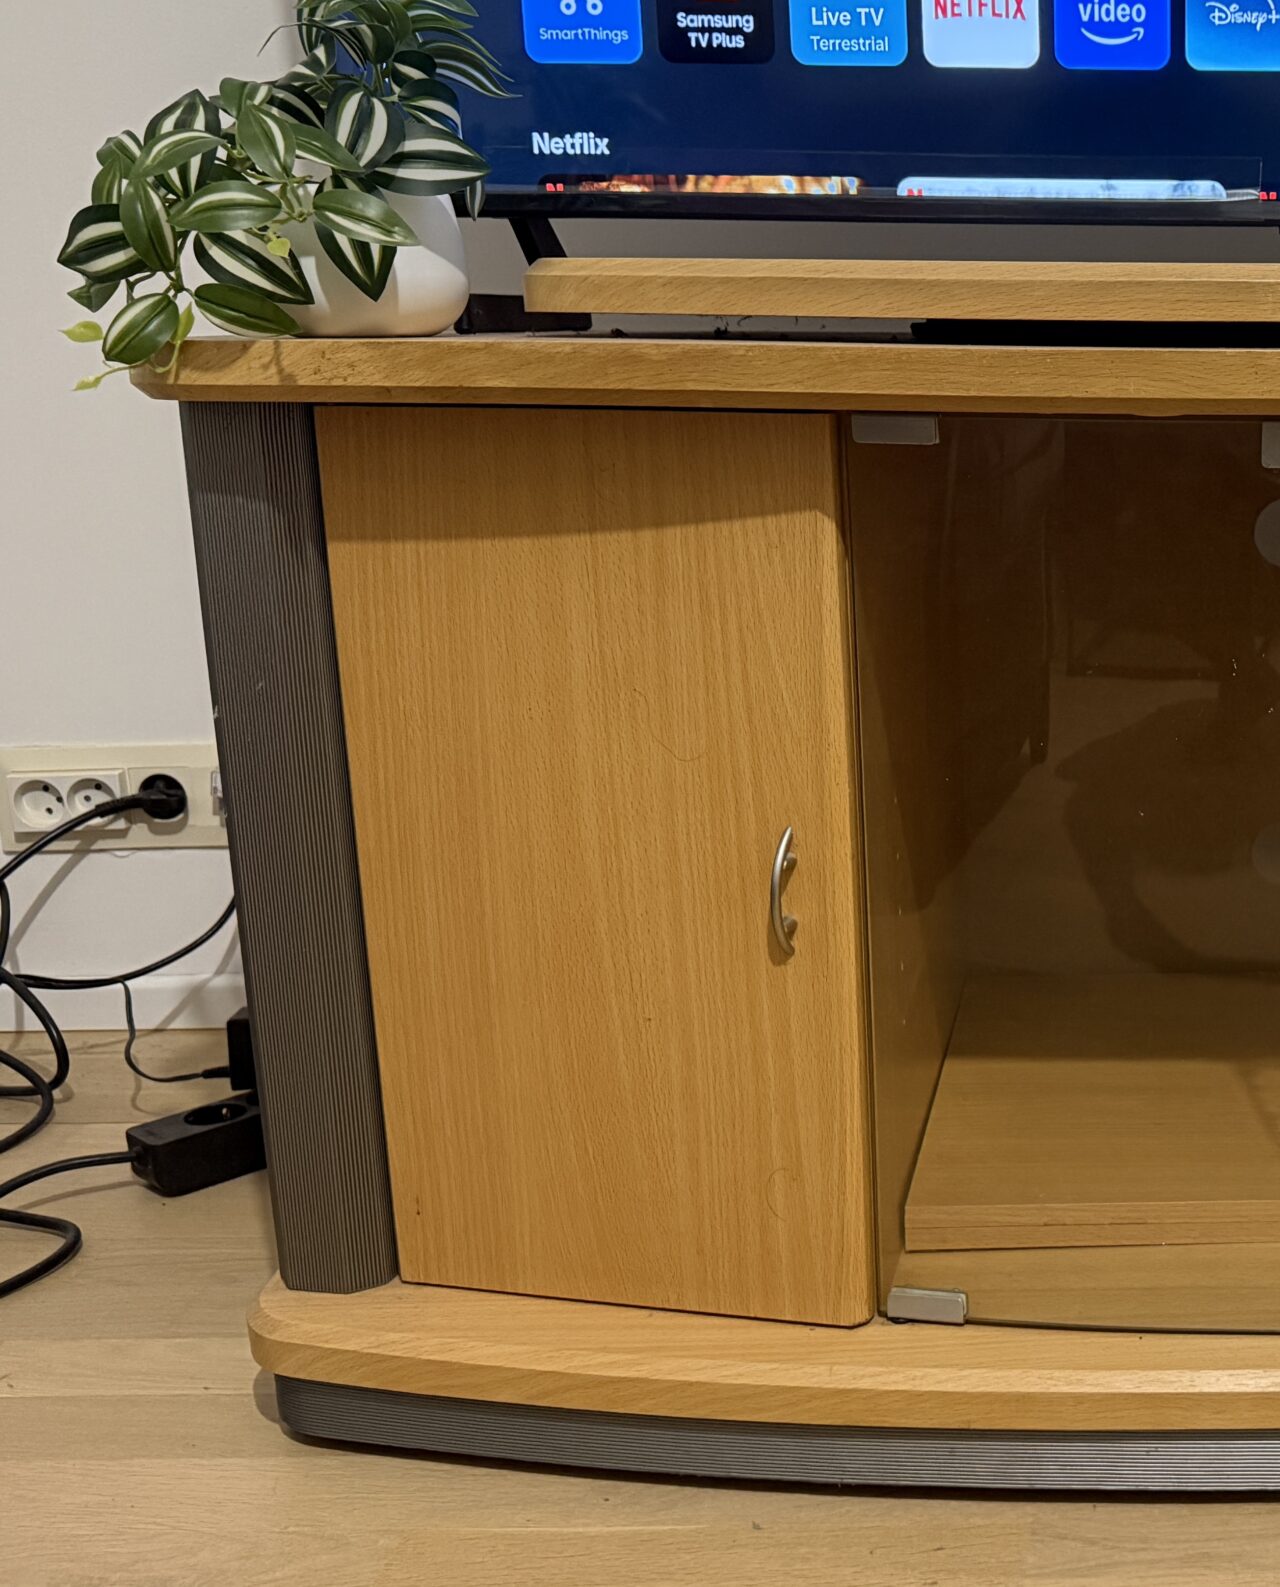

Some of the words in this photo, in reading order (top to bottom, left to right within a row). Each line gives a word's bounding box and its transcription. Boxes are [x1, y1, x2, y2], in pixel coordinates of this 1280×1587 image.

[811, 7, 852, 26] Live
[856, 8, 884, 26] TV
[933, 0, 1026, 20] NETFLIX
[1078, 0, 1147, 23] video
[676, 12, 755, 32] Samsung
[539, 28, 629, 44] SmartThings
[688, 32, 708, 48] TV
[712, 32, 745, 48] Plus
[810, 36, 889, 52] Terrestrial
[531, 132, 610, 155] Netflix
